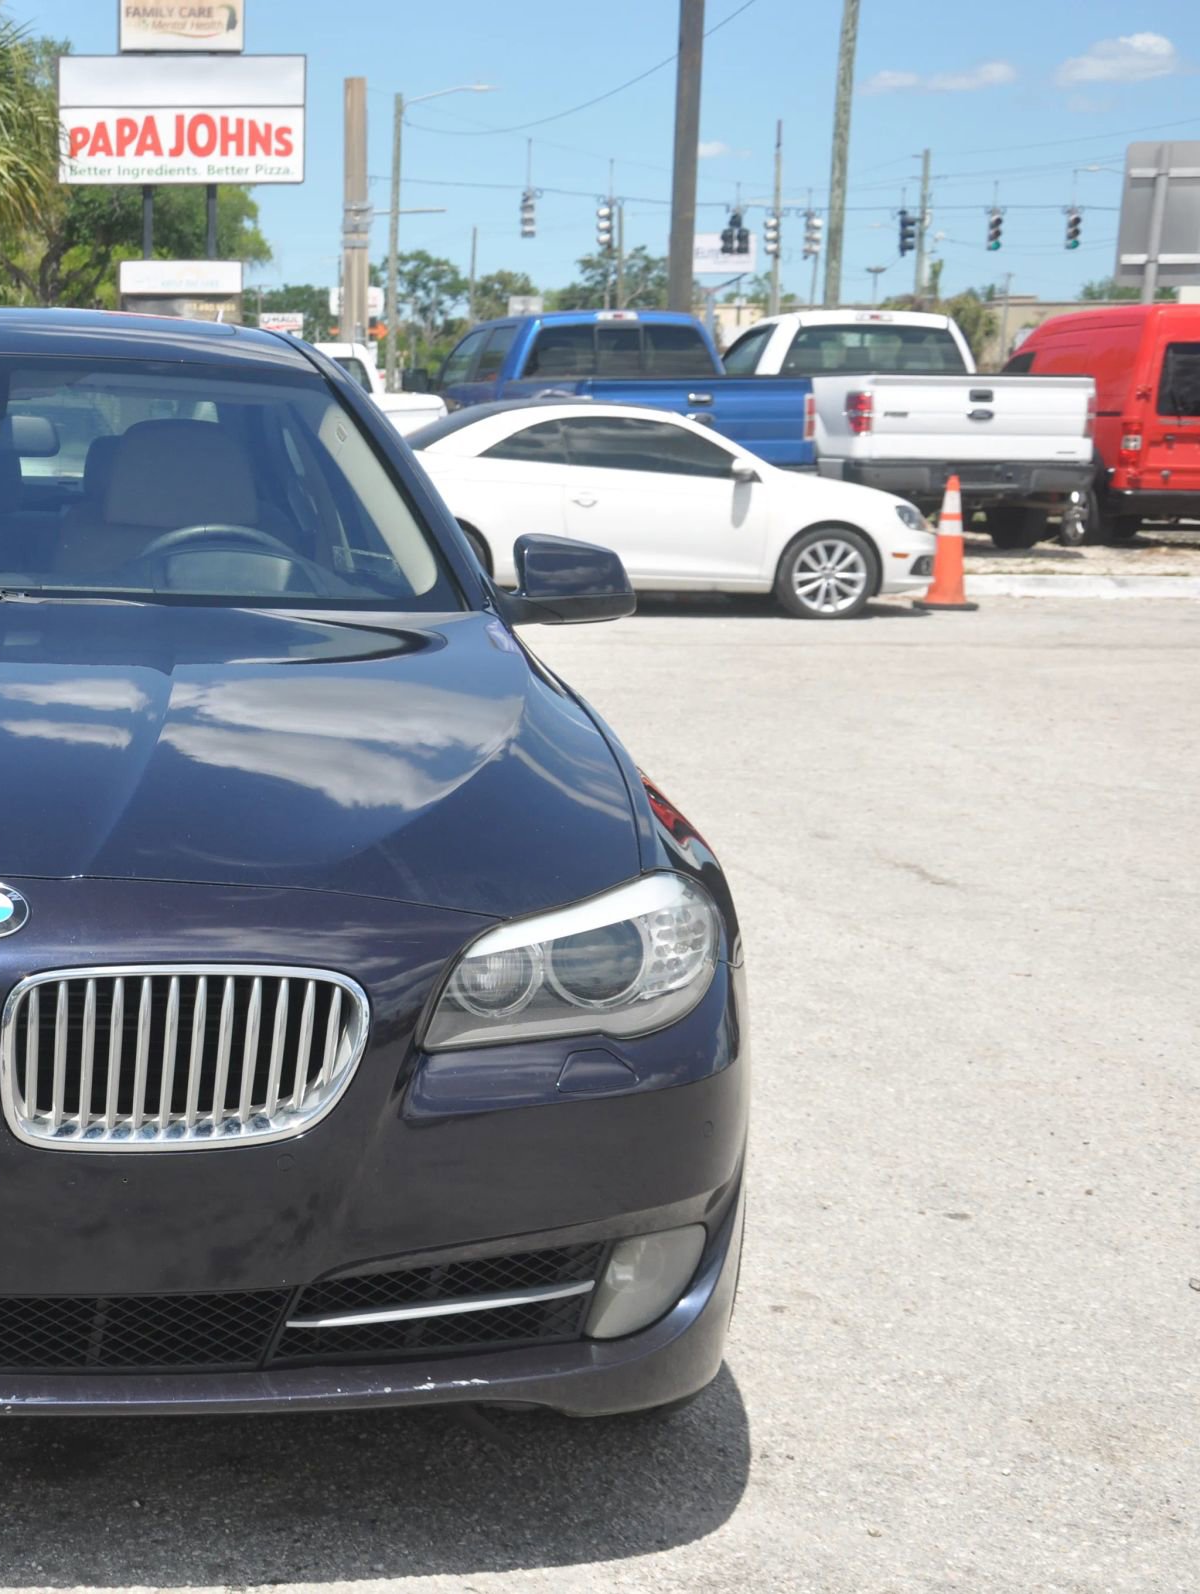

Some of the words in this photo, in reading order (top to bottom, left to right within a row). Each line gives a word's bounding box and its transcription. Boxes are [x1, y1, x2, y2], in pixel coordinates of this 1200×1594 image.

[125, 6, 174, 18] FAMILY
[178, 6, 214, 18] CARE
[69, 115, 164, 158] PAPA
[169, 113, 294, 158] JOHNS
[69, 164, 112, 177] Better
[117, 164, 201, 179] Ingredients.
[207, 164, 251, 176] Better
[255, 164, 295, 176] Pizza.
